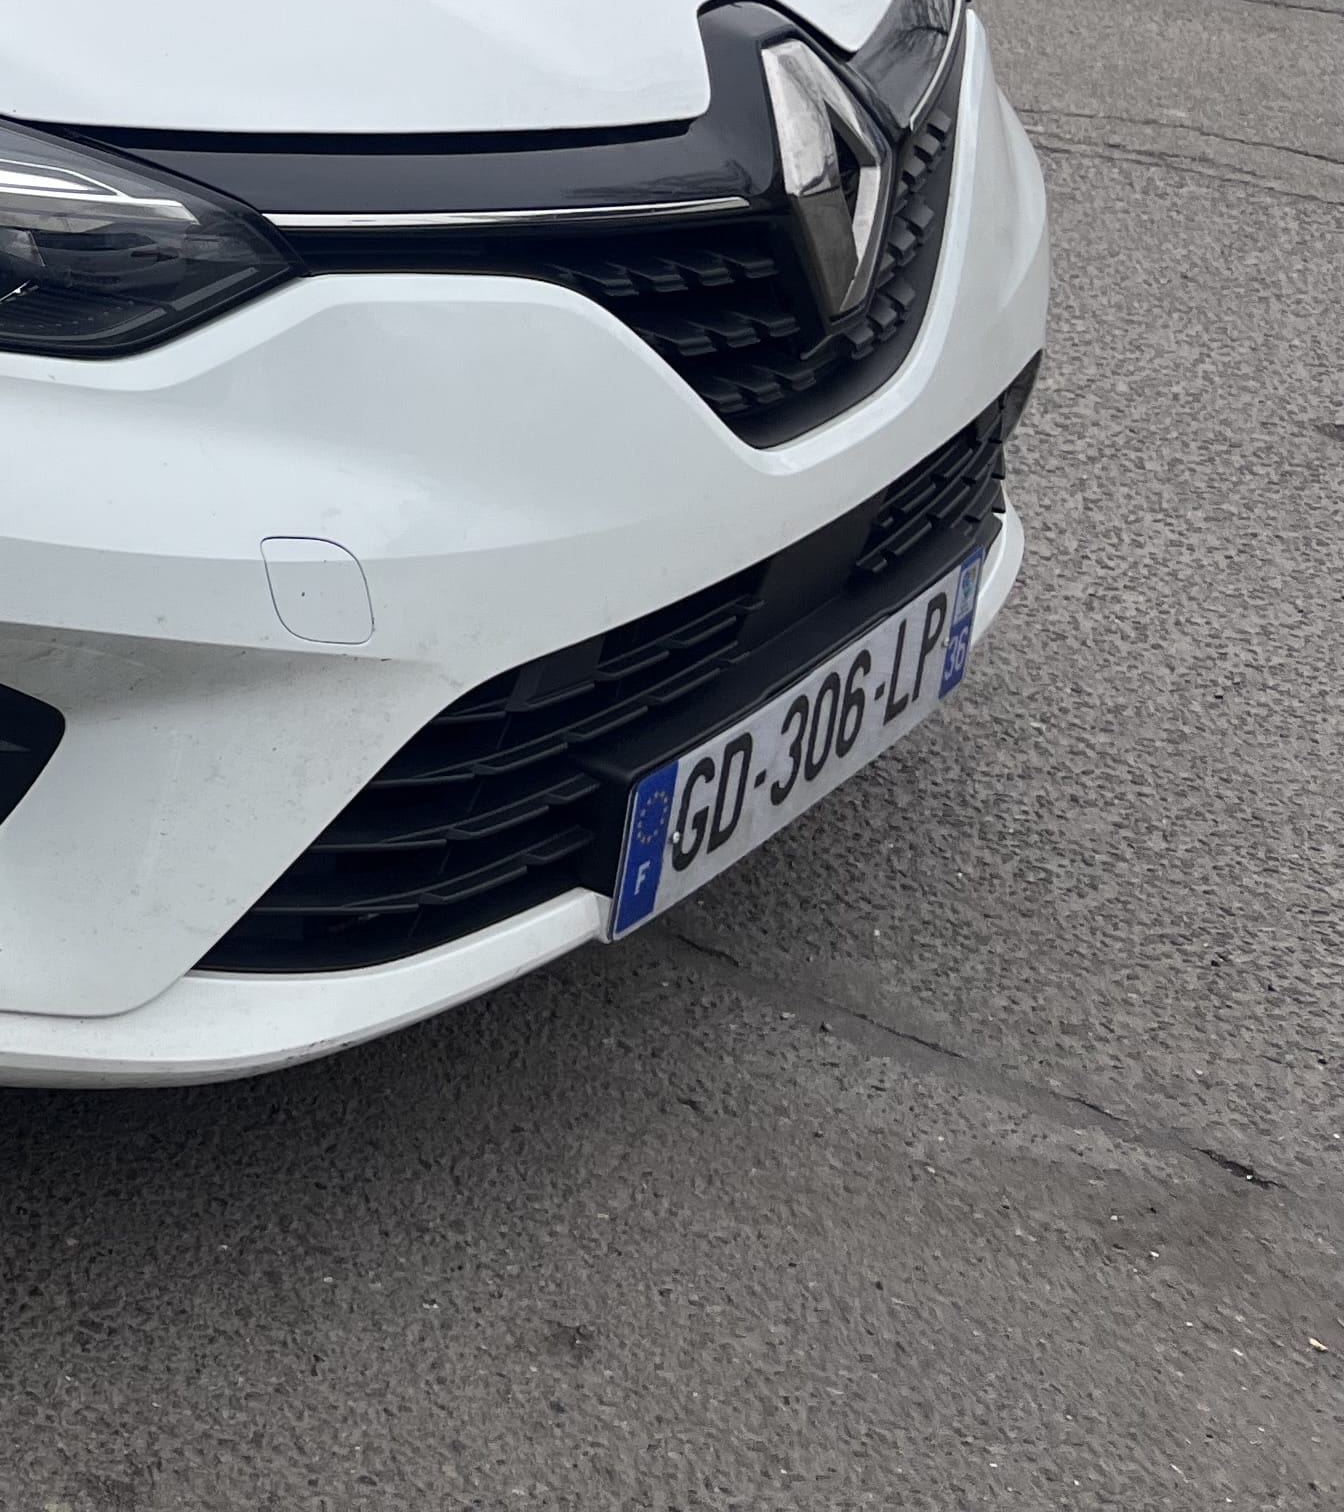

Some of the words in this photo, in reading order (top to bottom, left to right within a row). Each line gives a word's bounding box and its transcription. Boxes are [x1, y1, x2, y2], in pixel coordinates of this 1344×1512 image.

[944, 626, 969, 680] 36
[670, 591, 948, 872] GD-306-LP
[633, 861, 651, 896] F
